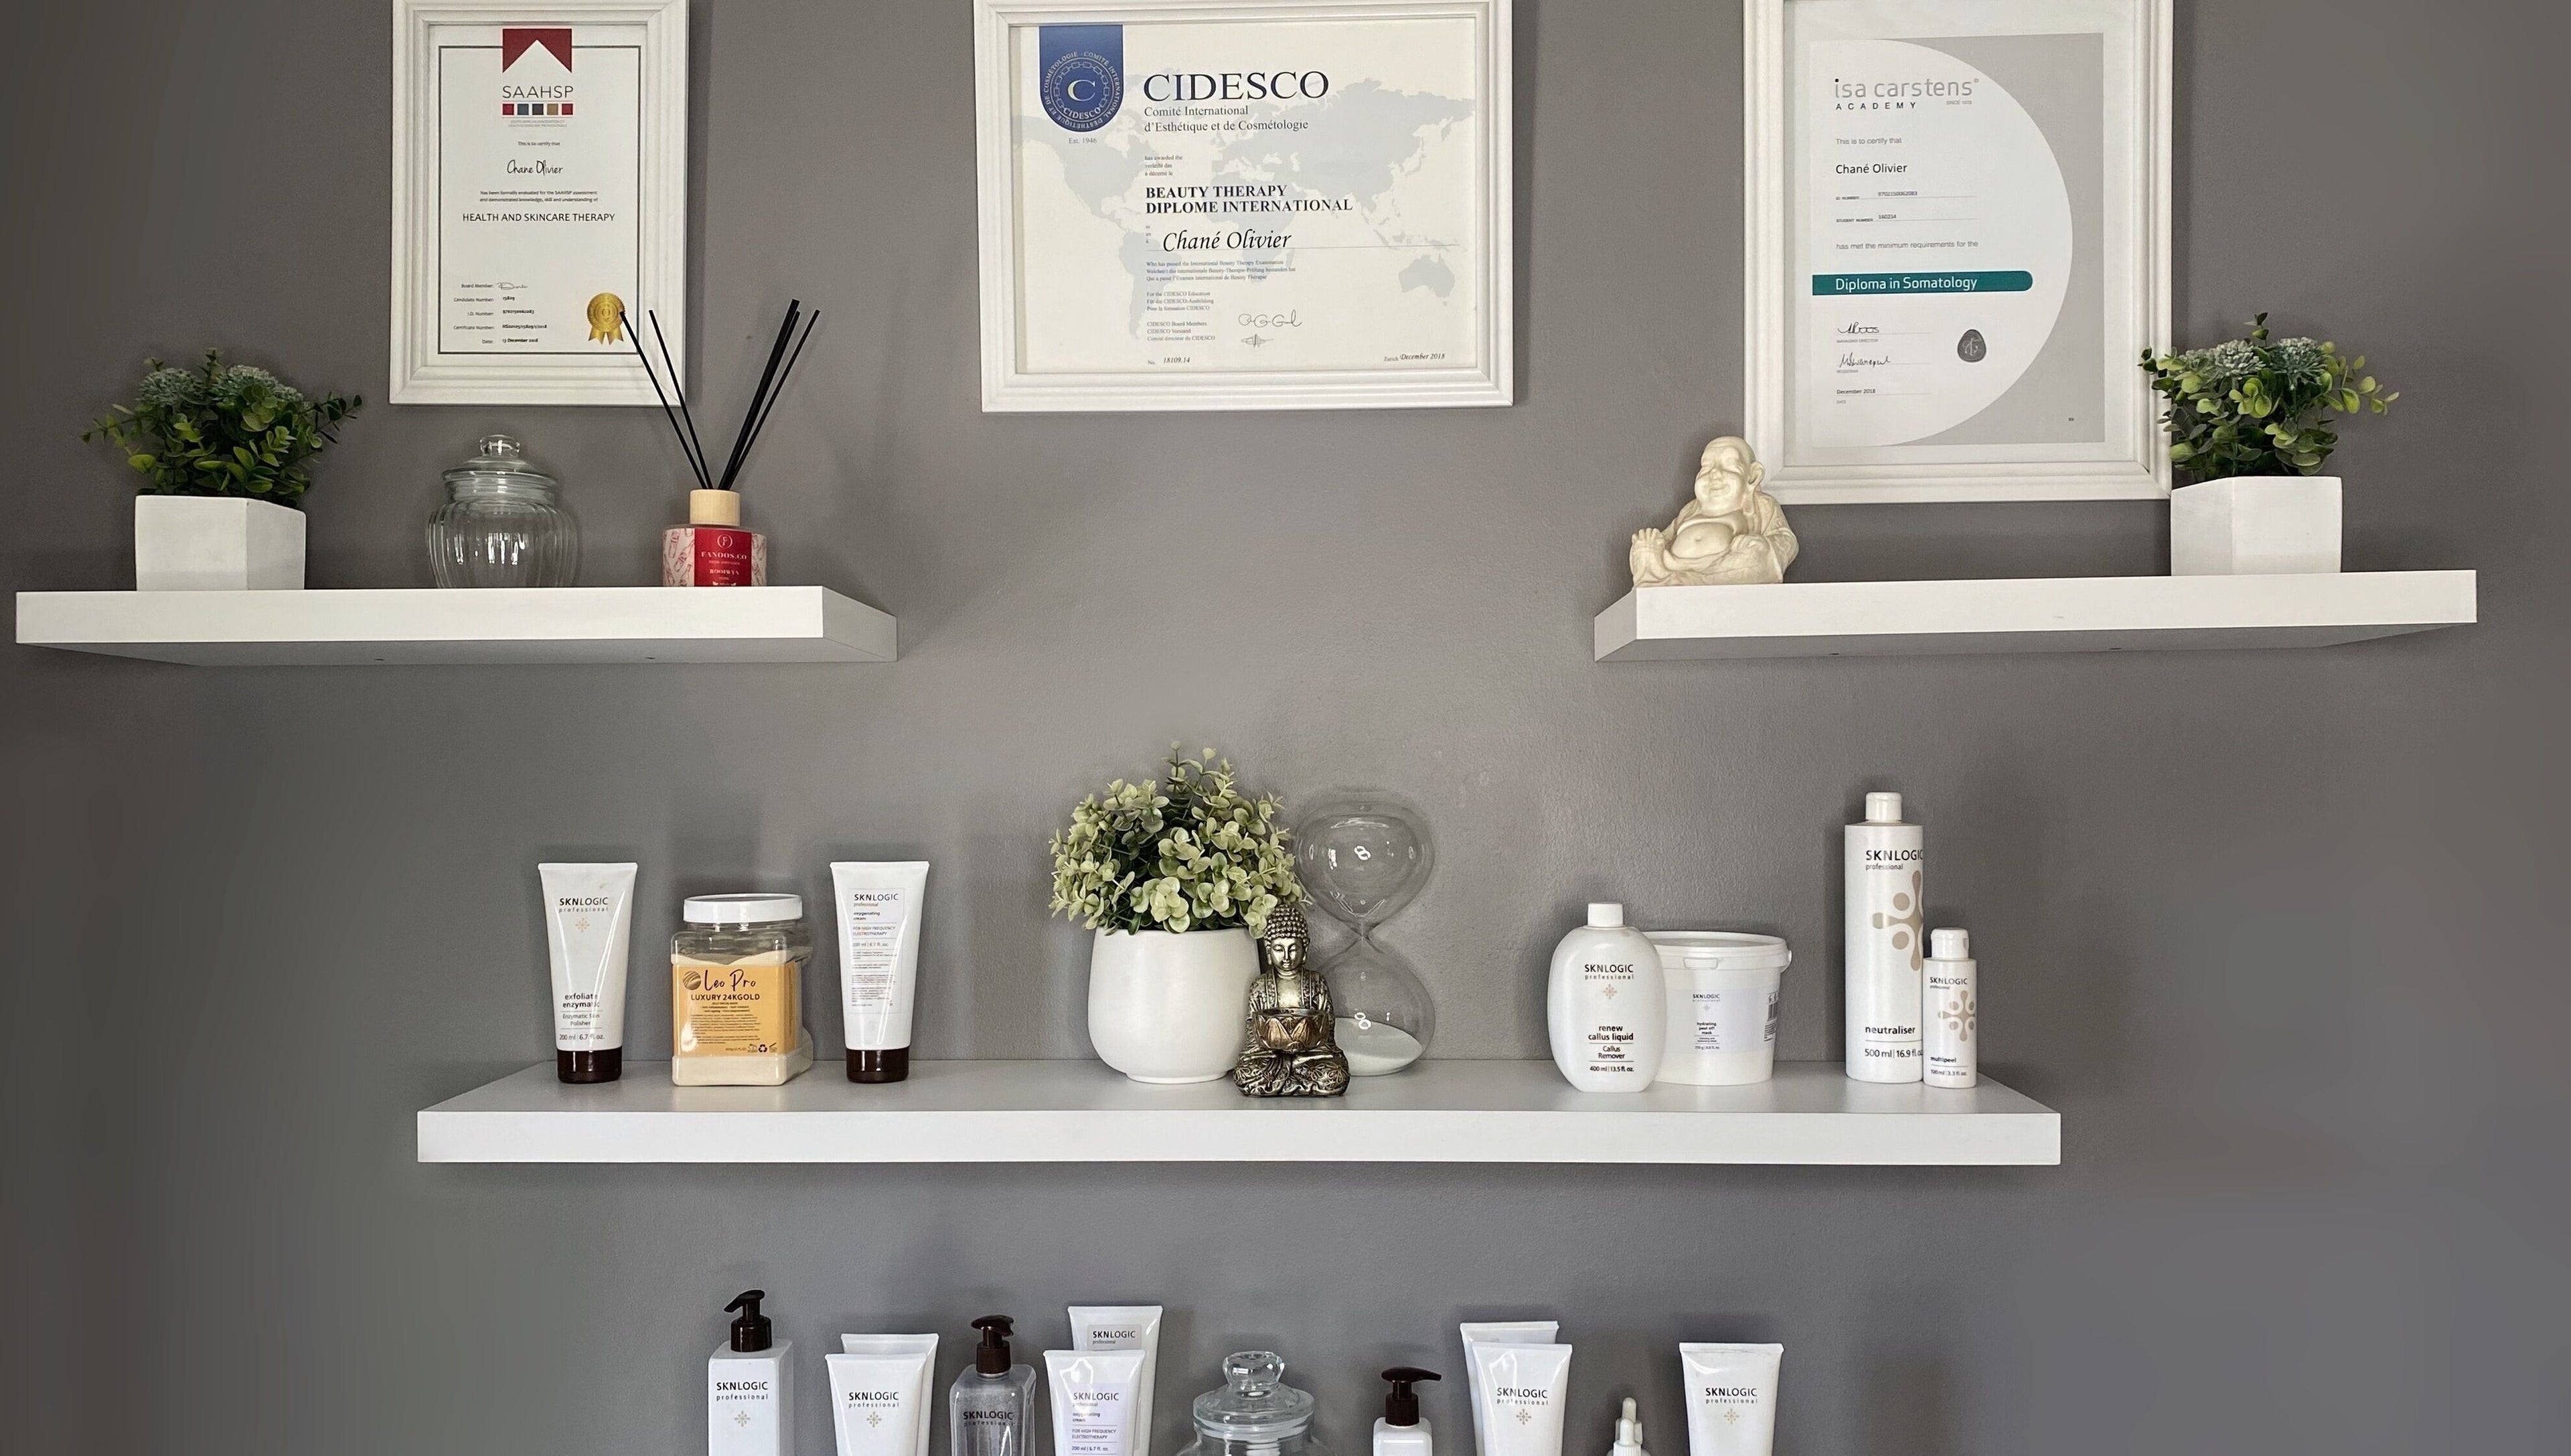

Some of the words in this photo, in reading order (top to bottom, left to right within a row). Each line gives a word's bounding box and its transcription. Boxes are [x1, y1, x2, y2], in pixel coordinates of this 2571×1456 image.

[1067, 79, 1096, 101] C
[1143, 70, 1330, 102] CIDESCO
[1835, 78, 1866, 98] isa
[1874, 78, 1972, 97] carstens
[502, 85, 574, 98] SAAHSP
[1104, 66, 1121, 118] INTERNATIONAL
[1144, 106, 1182, 116] Comité
[1184, 104, 1249, 116] International
[1836, 102, 1917, 110] ACADEMY
[1063, 106, 1101, 119] CIDESCO
[1210, 122, 1221, 132] et
[1223, 120, 1237, 131] de
[1238, 119, 1309, 133] Cosmétologie
[536, 160, 563, 176] Olivier
[1835, 164, 1869, 174] Chané
[1872, 163, 1907, 173] Olivier
[1146, 186, 1209, 198] BEAUTY
[1213, 185, 1288, 197] THERAPY
[1146, 201, 1219, 214] DIPLOME
[1223, 199, 1353, 213] INTERNATIONAL
[463, 213, 499, 222] HEALTH
[501, 213, 522, 222] AND
[524, 213, 570, 222] SKINCARE
[573, 213, 615, 222] THERAPY
[1162, 229, 1221, 252] Chané
[1227, 228, 1292, 250] Olivier
[1910, 241, 1955, 250] requirements
[1835, 277, 1887, 293] Diploma
[1889, 276, 1901, 289] in
[1903, 276, 1978, 291] Somatology
[1399, 352, 1429, 360] December
[1865, 863, 1903, 871] professional
[559, 897, 609, 906] SKNLOGIC
[854, 893, 899, 901] SKNLOGIC
[1584, 964, 1634, 973] SKNLOGIC
[704, 969, 725, 991] Leo
[729, 969, 757, 991] Pro
[1930, 977, 1968, 985] SKNLOGIC
[1865, 1026, 1916, 1034] neutraliser
[1612, 1033, 1634, 1042] liquid
[1865, 1048, 1880, 1057] 500
[1881, 1049, 1892, 1057] ml
[1896, 1049, 1911, 1058] 16.9
[1092, 1330, 1136, 1339] SKNLOGIC
[716, 1382, 768, 1390] SKNLOGIC
[848, 1392, 899, 1401] SKNLOGIC
[1073, 1392, 1119, 1400] SKNLOGIC
[1497, 1387, 1548, 1398] SKNLOGIC
[1705, 1388, 1758, 1396] SKNLOGIC
[963, 1410, 1014, 1421] SKNLOGIC
